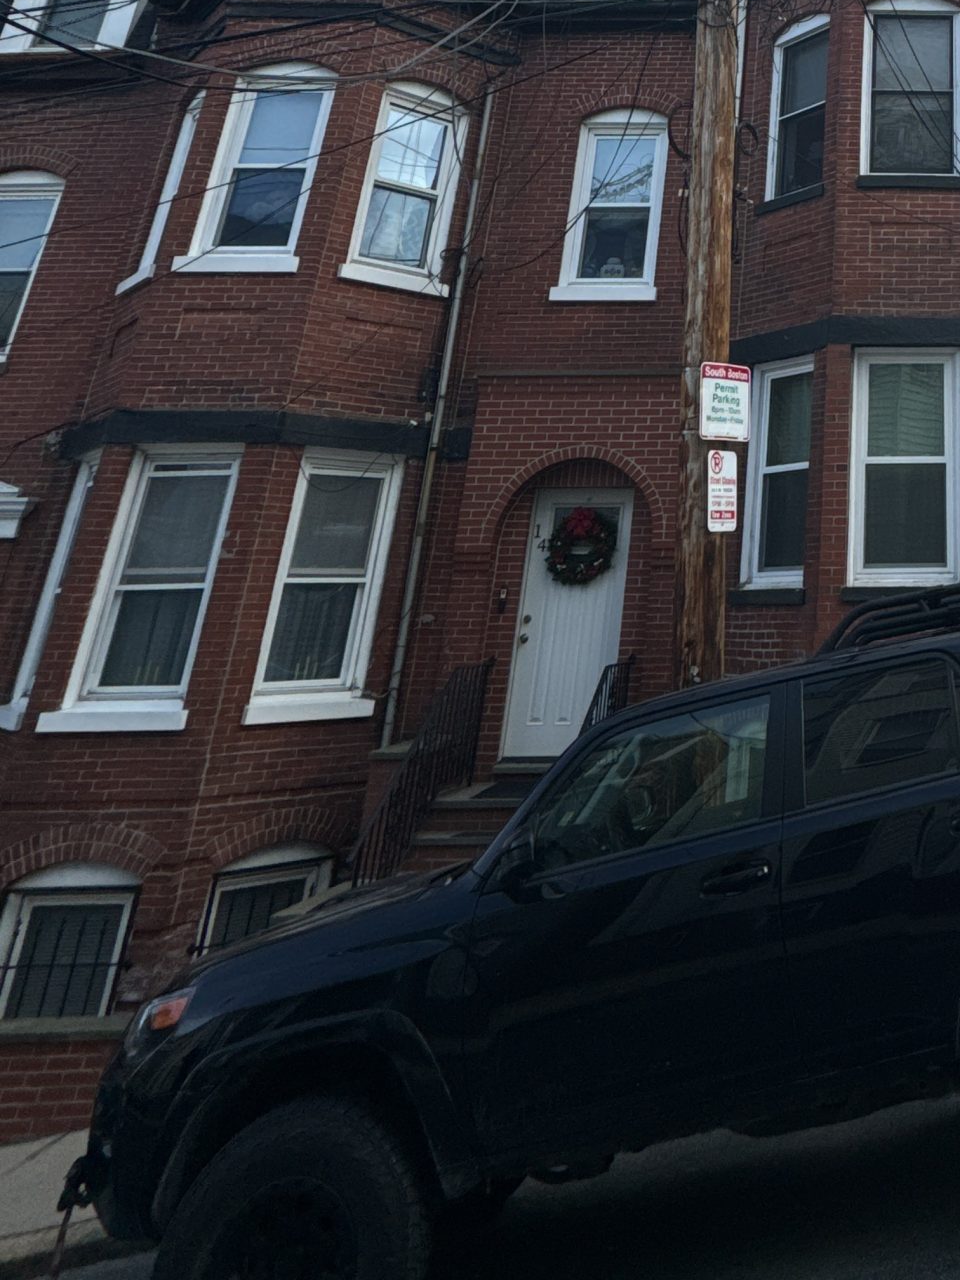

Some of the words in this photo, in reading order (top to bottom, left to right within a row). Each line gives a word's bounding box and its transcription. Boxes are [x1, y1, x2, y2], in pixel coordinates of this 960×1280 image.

[705, 366, 726, 377] South
[728, 369, 748, 381] Boston
[715, 383, 738, 394] Permit
[712, 393, 740, 407] Parking
